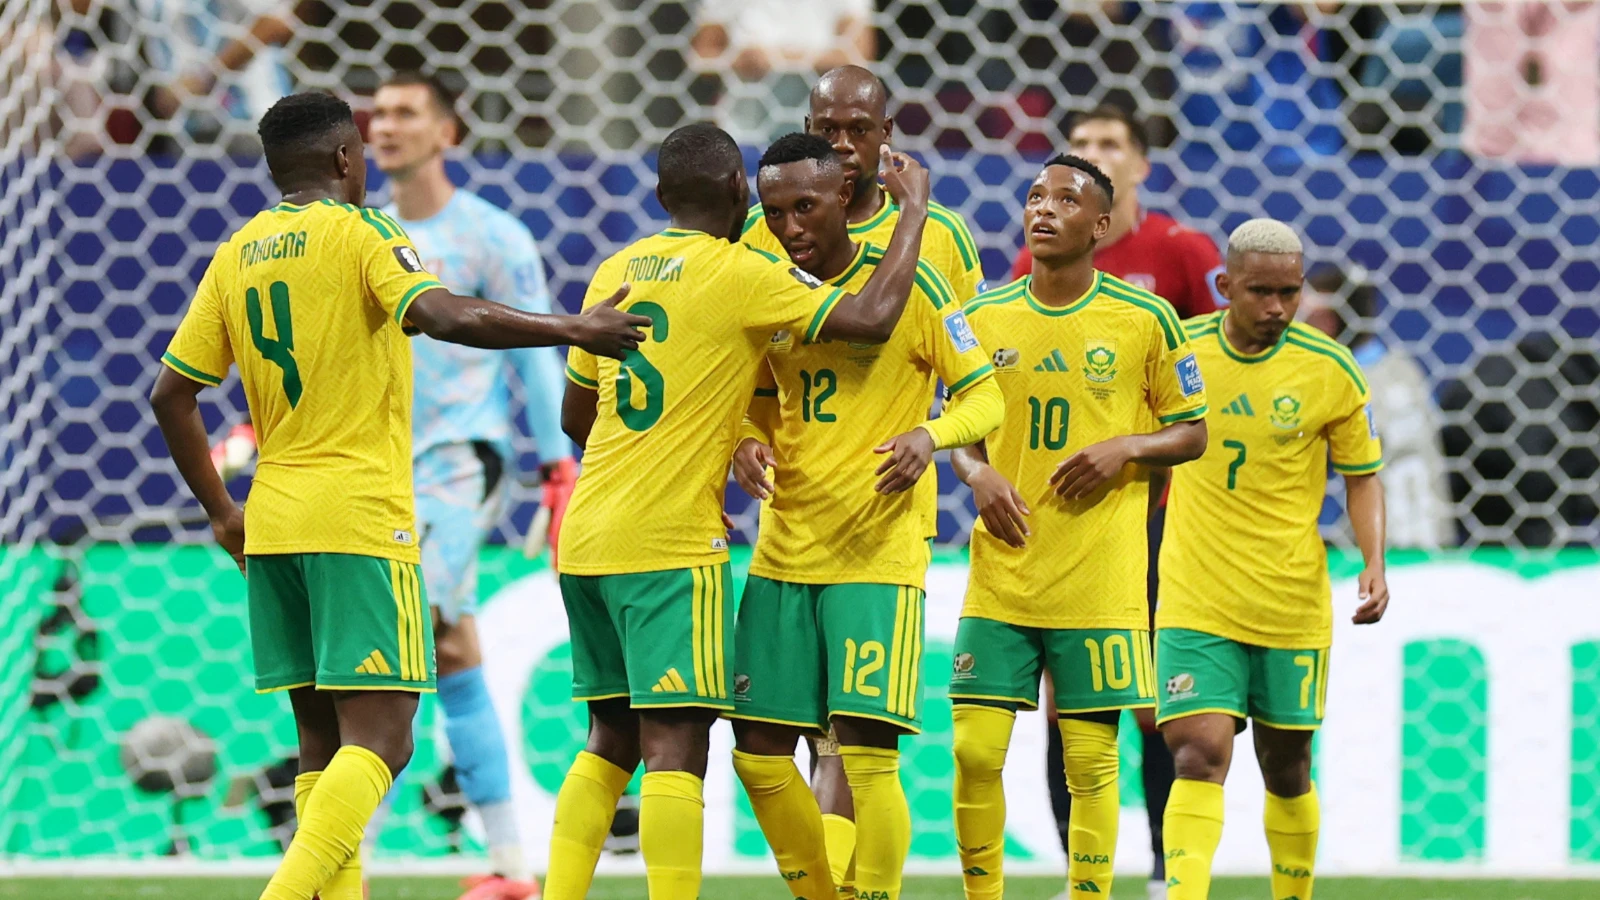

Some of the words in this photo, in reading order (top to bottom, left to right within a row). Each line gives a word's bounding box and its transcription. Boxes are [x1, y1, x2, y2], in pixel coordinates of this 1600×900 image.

[246, 281, 303, 411] 4
[799, 369, 837, 422] 12
[1028, 396, 1070, 450] 10
[1223, 439, 1247, 490] 7
[842, 638, 885, 697] 12
[1084, 635, 1131, 692] 10
[1294, 655, 1315, 709] 7
[1073, 852, 1109, 864] SAFA
[1275, 863, 1311, 879] SAFA
